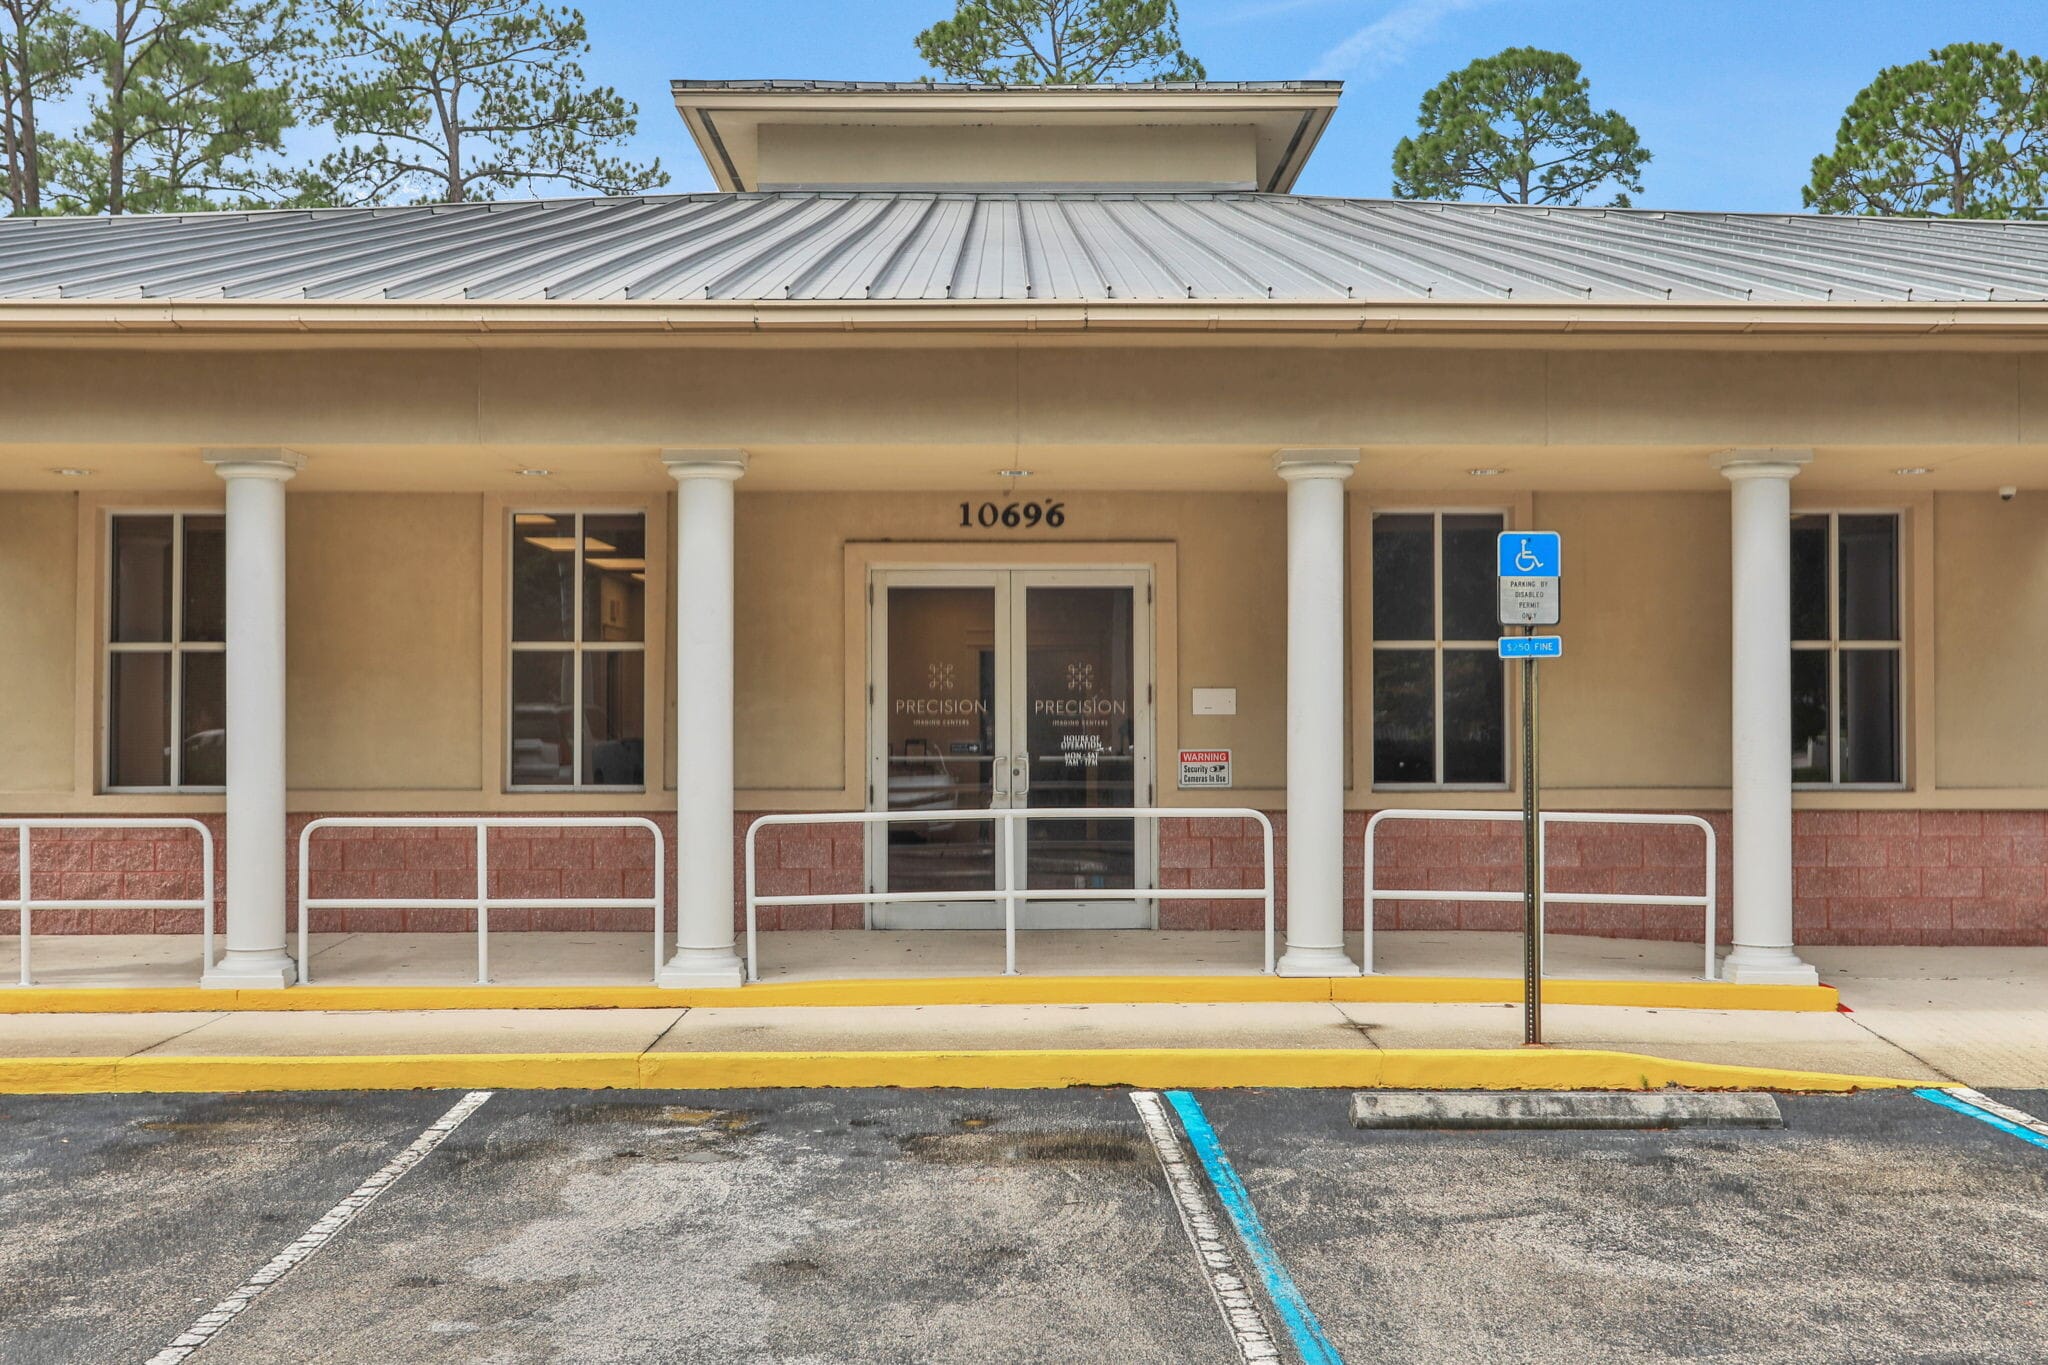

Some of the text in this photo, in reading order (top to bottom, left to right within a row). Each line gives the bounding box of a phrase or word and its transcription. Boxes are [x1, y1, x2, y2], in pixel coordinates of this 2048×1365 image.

[959, 501, 1065, 528] 10696
[1506, 642, 1553, 651] $250 FINE
[896, 699, 988, 714] PRECISION
[1035, 699, 1126, 715] PRECISION
[1063, 734, 1089, 742] HOURS
[1060, 741, 1102, 750] OPERATION
[1183, 752, 1227, 761] WARNING
[1183, 765, 1208, 774] Security
[1183, 775, 1226, 783] Cameras In Use
